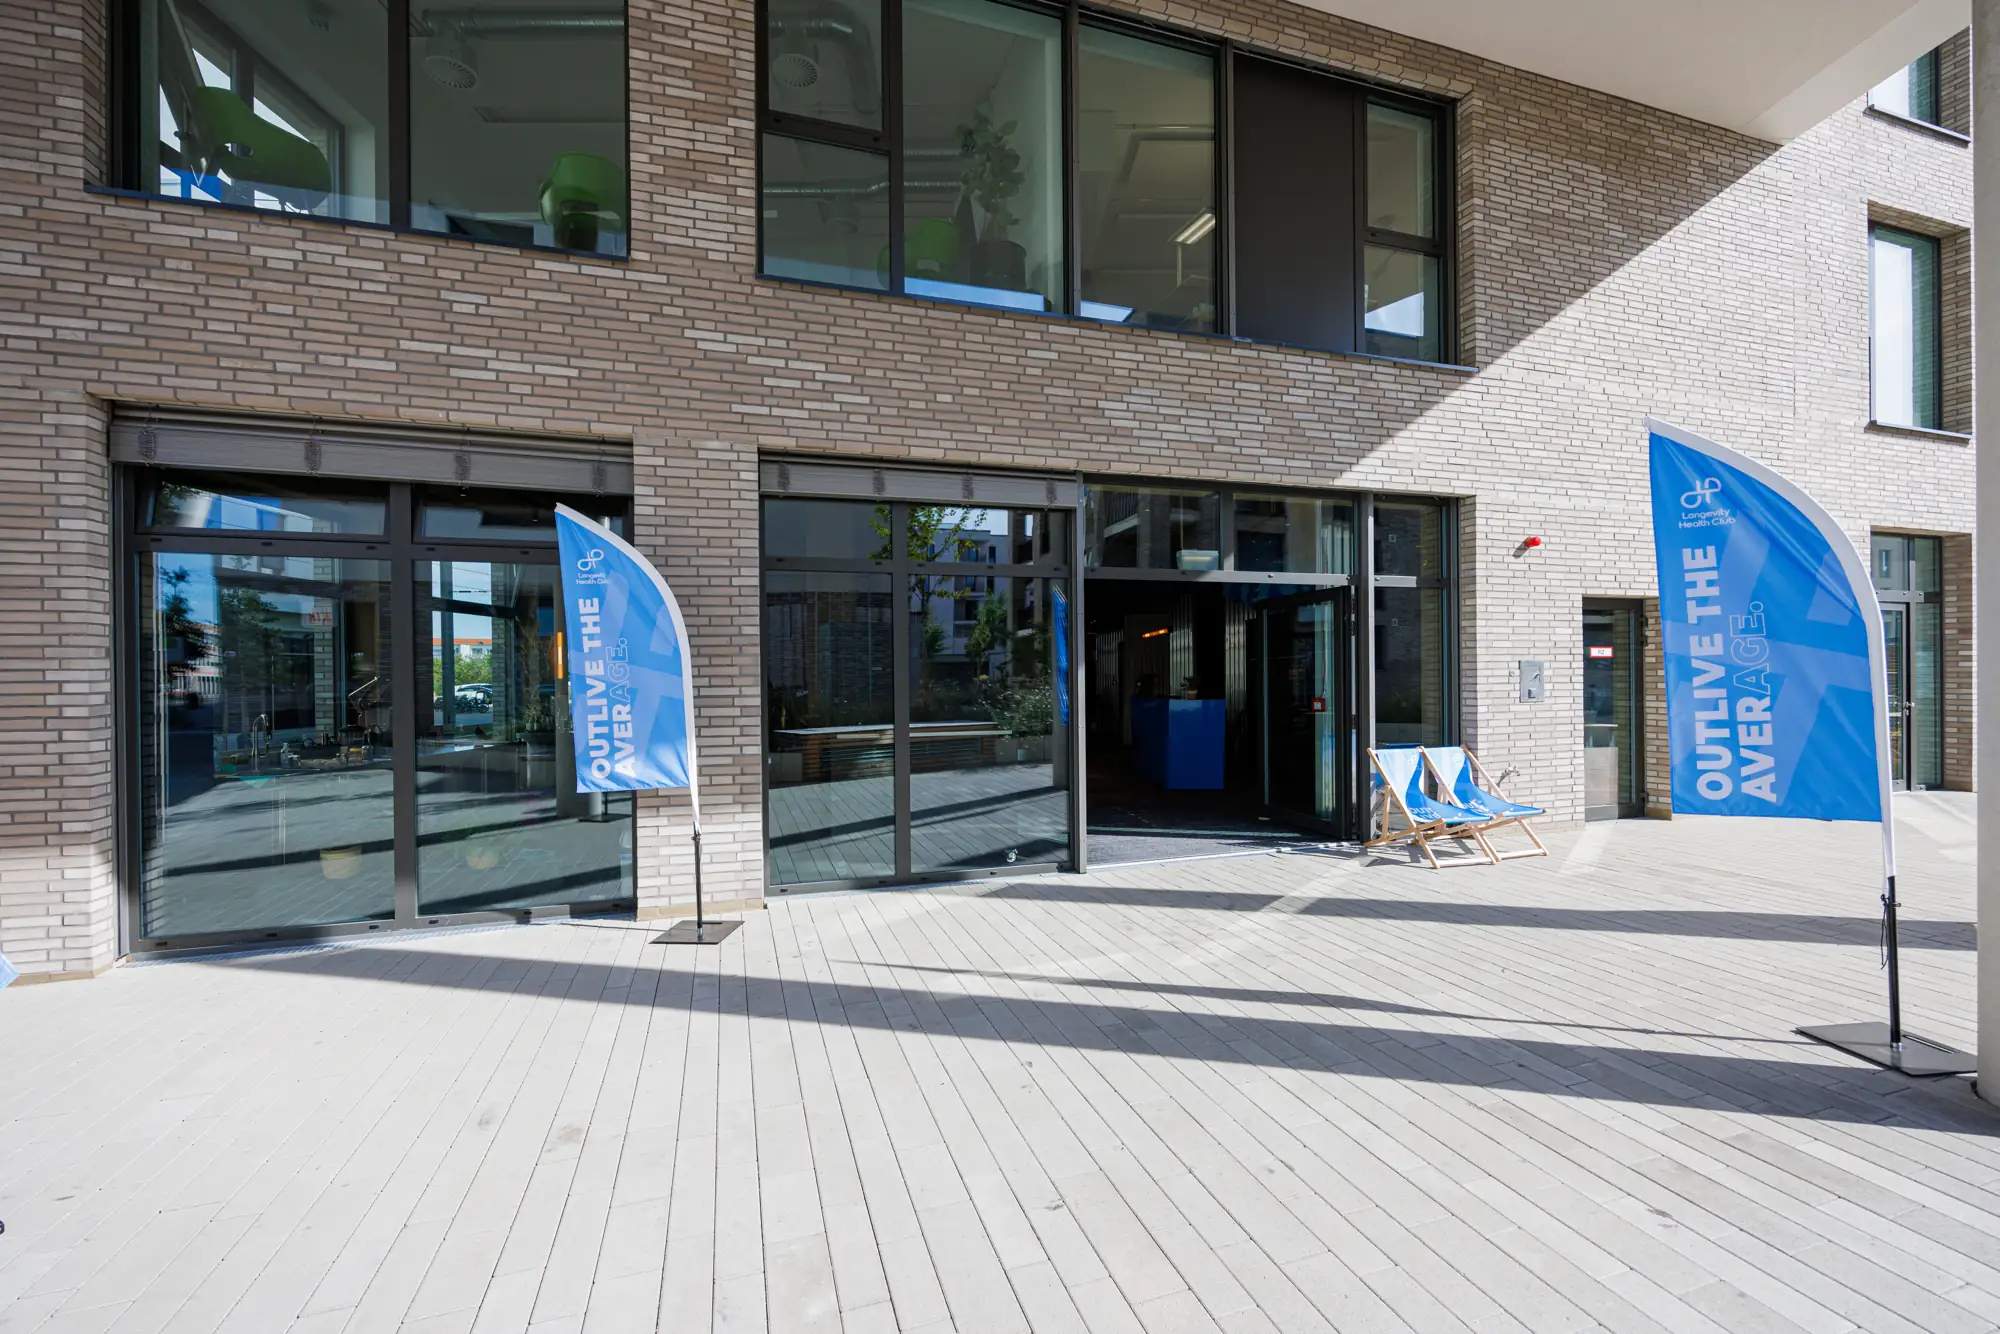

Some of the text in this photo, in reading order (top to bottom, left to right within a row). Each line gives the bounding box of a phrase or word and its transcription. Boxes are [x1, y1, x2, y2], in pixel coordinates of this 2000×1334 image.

[1679, 517, 1736, 528] Health Club
[1681, 508, 1730, 519] Longevity
[578, 597, 611, 779] OUTLIVE THE
[606, 637, 637, 778] AVERAGE.
[1682, 545, 1733, 801] OUTLIVE THE
[1729, 601, 1777, 803] AVERAGE.
